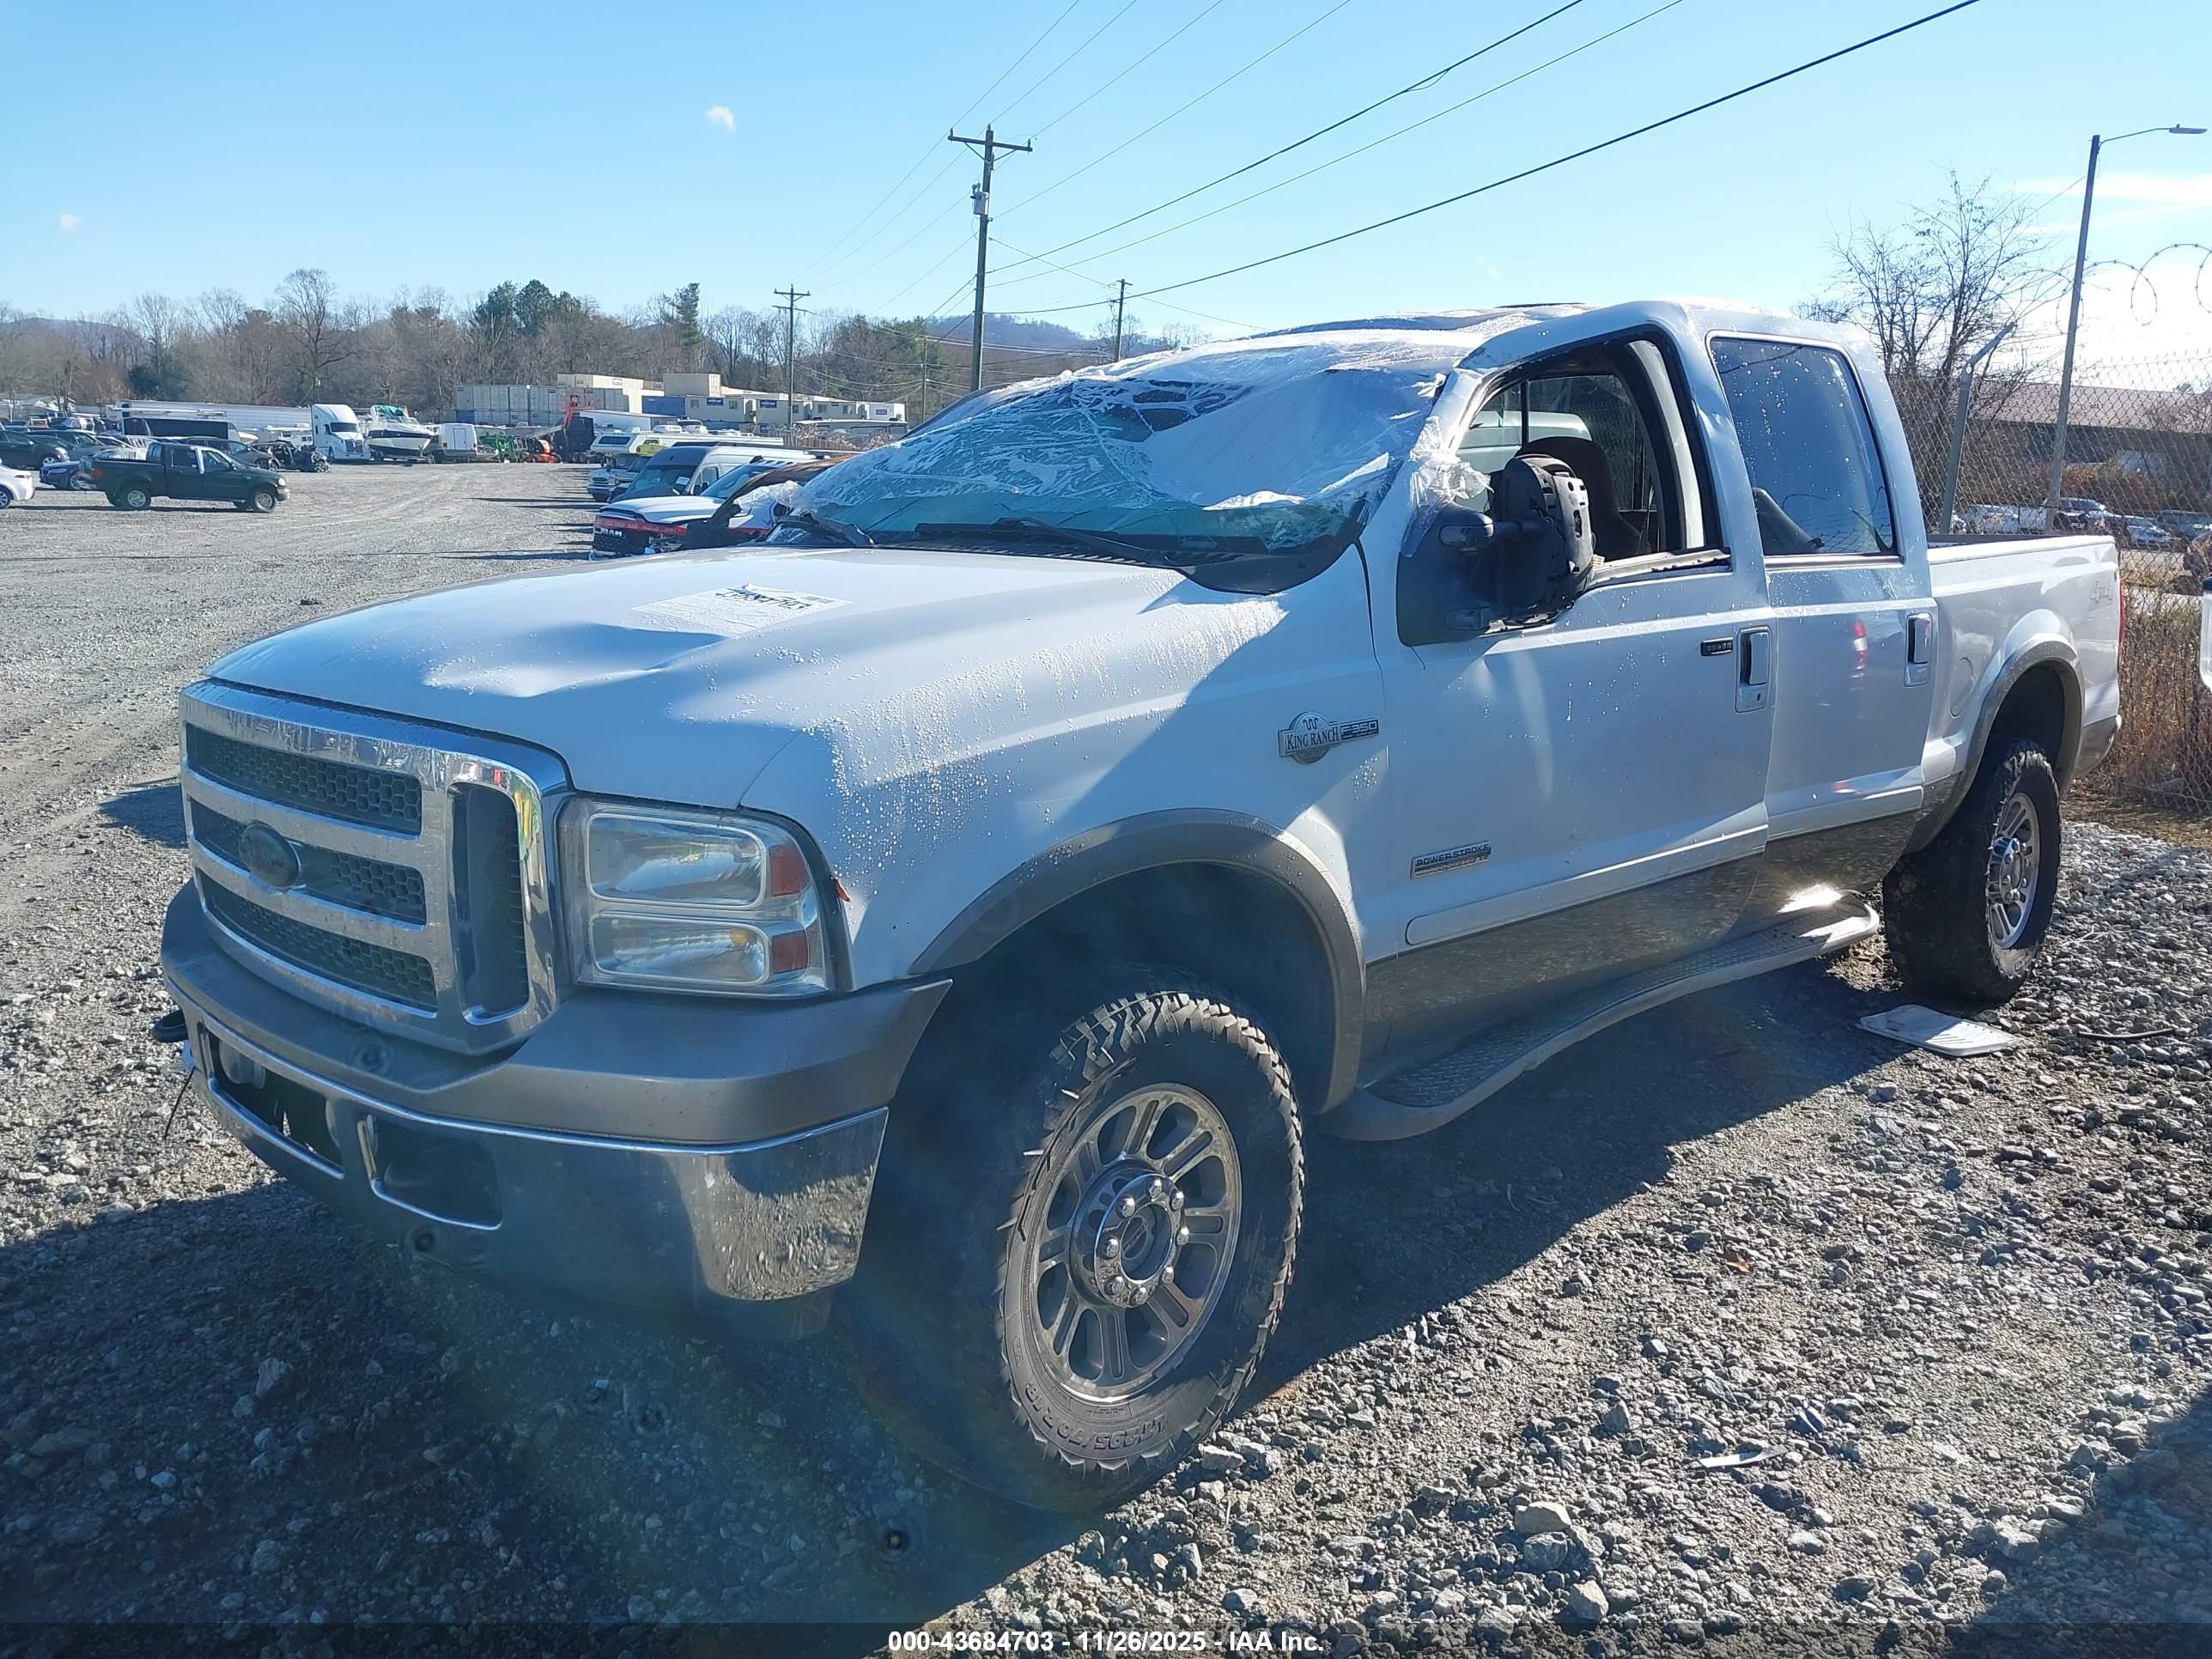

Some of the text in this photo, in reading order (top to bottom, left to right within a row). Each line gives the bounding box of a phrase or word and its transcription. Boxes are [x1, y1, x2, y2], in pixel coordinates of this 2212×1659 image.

[603, 528, 623, 537] RAM
[1286, 732, 1309, 750] KING
[1310, 726, 1340, 746] RANCH
